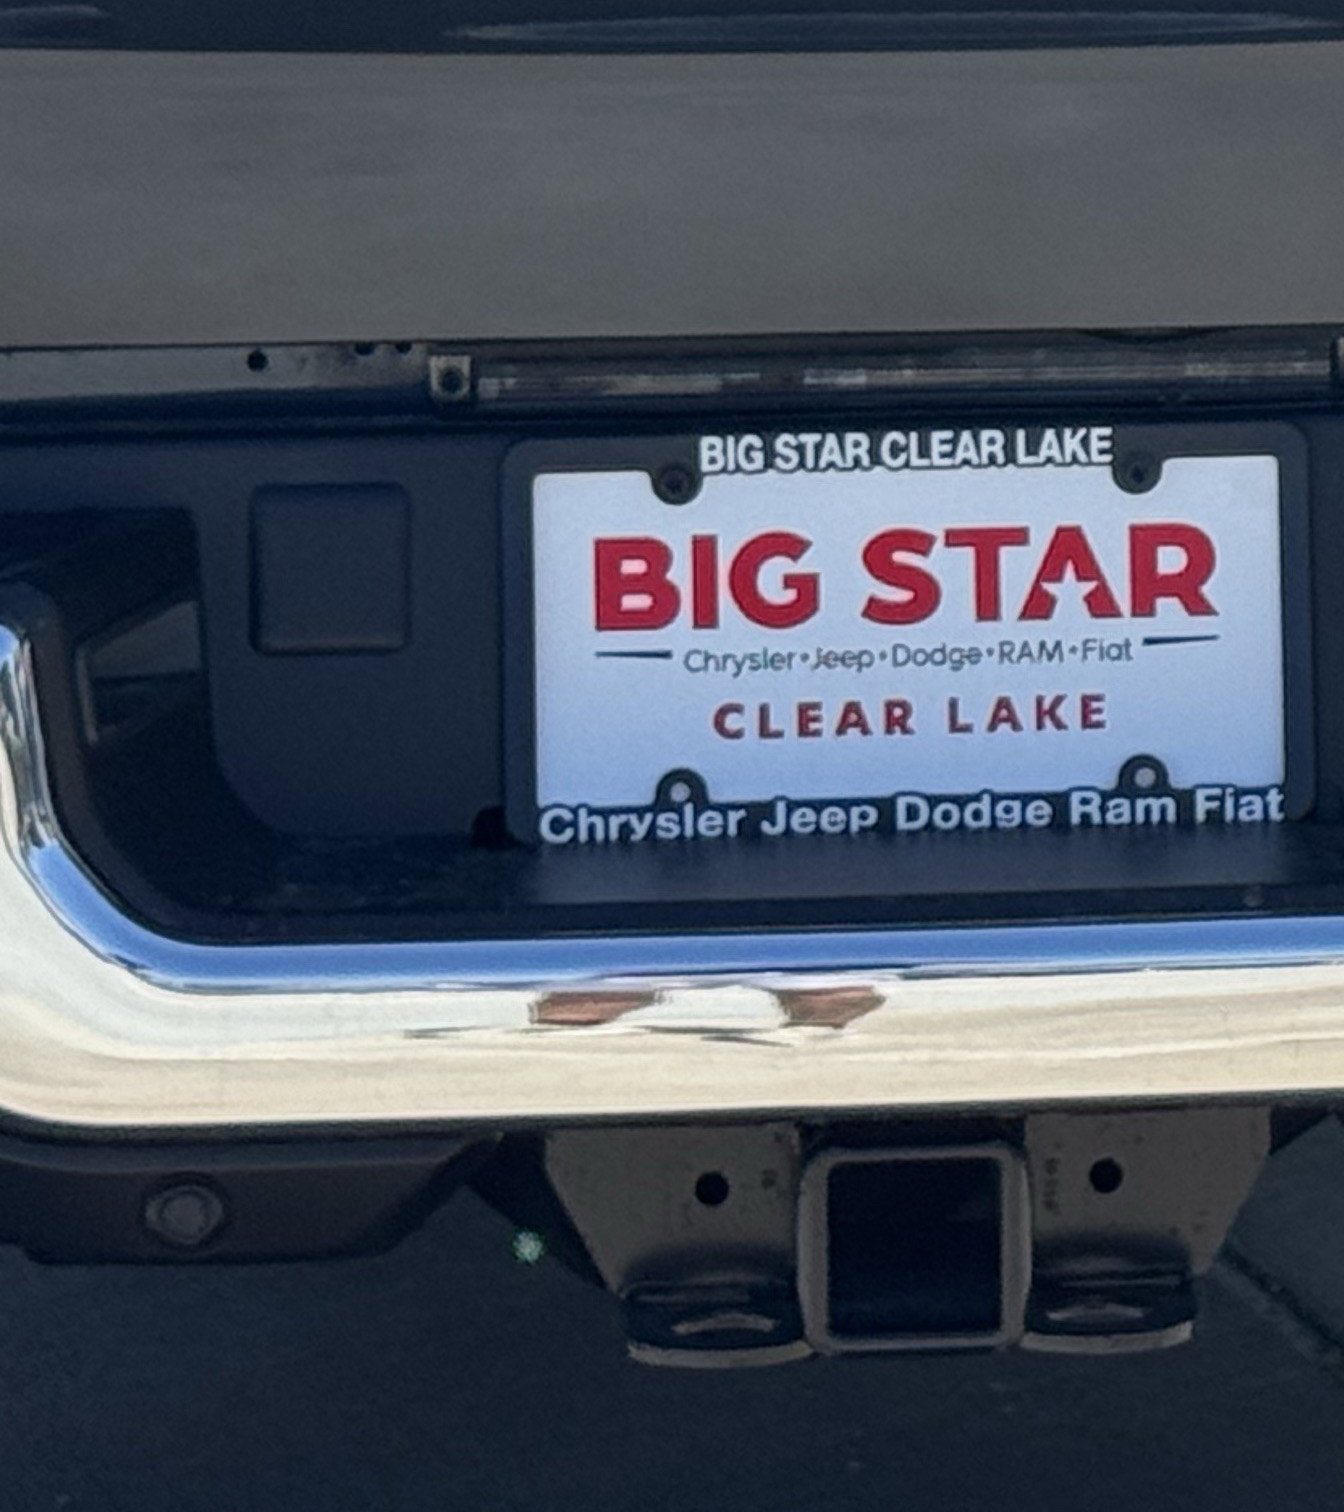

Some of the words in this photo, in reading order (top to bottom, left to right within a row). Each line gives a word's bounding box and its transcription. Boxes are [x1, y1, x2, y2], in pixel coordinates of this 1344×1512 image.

[701, 434, 764, 472] BIG
[774, 432, 870, 471] STAR
[880, 429, 1005, 468] CLEAR
[1015, 426, 1114, 465] LAKE
[593, 530, 821, 632] BIG
[861, 522, 1221, 625] STAR
[712, 698, 916, 740] CLEAR
[946, 693, 1108, 734] LAKE
[538, 802, 746, 846] Chrysler
[759, 797, 879, 839] Jeep
[898, 791, 1053, 833] Dodge
[1070, 789, 1177, 827] Ram
[1197, 785, 1285, 822] Fiat
